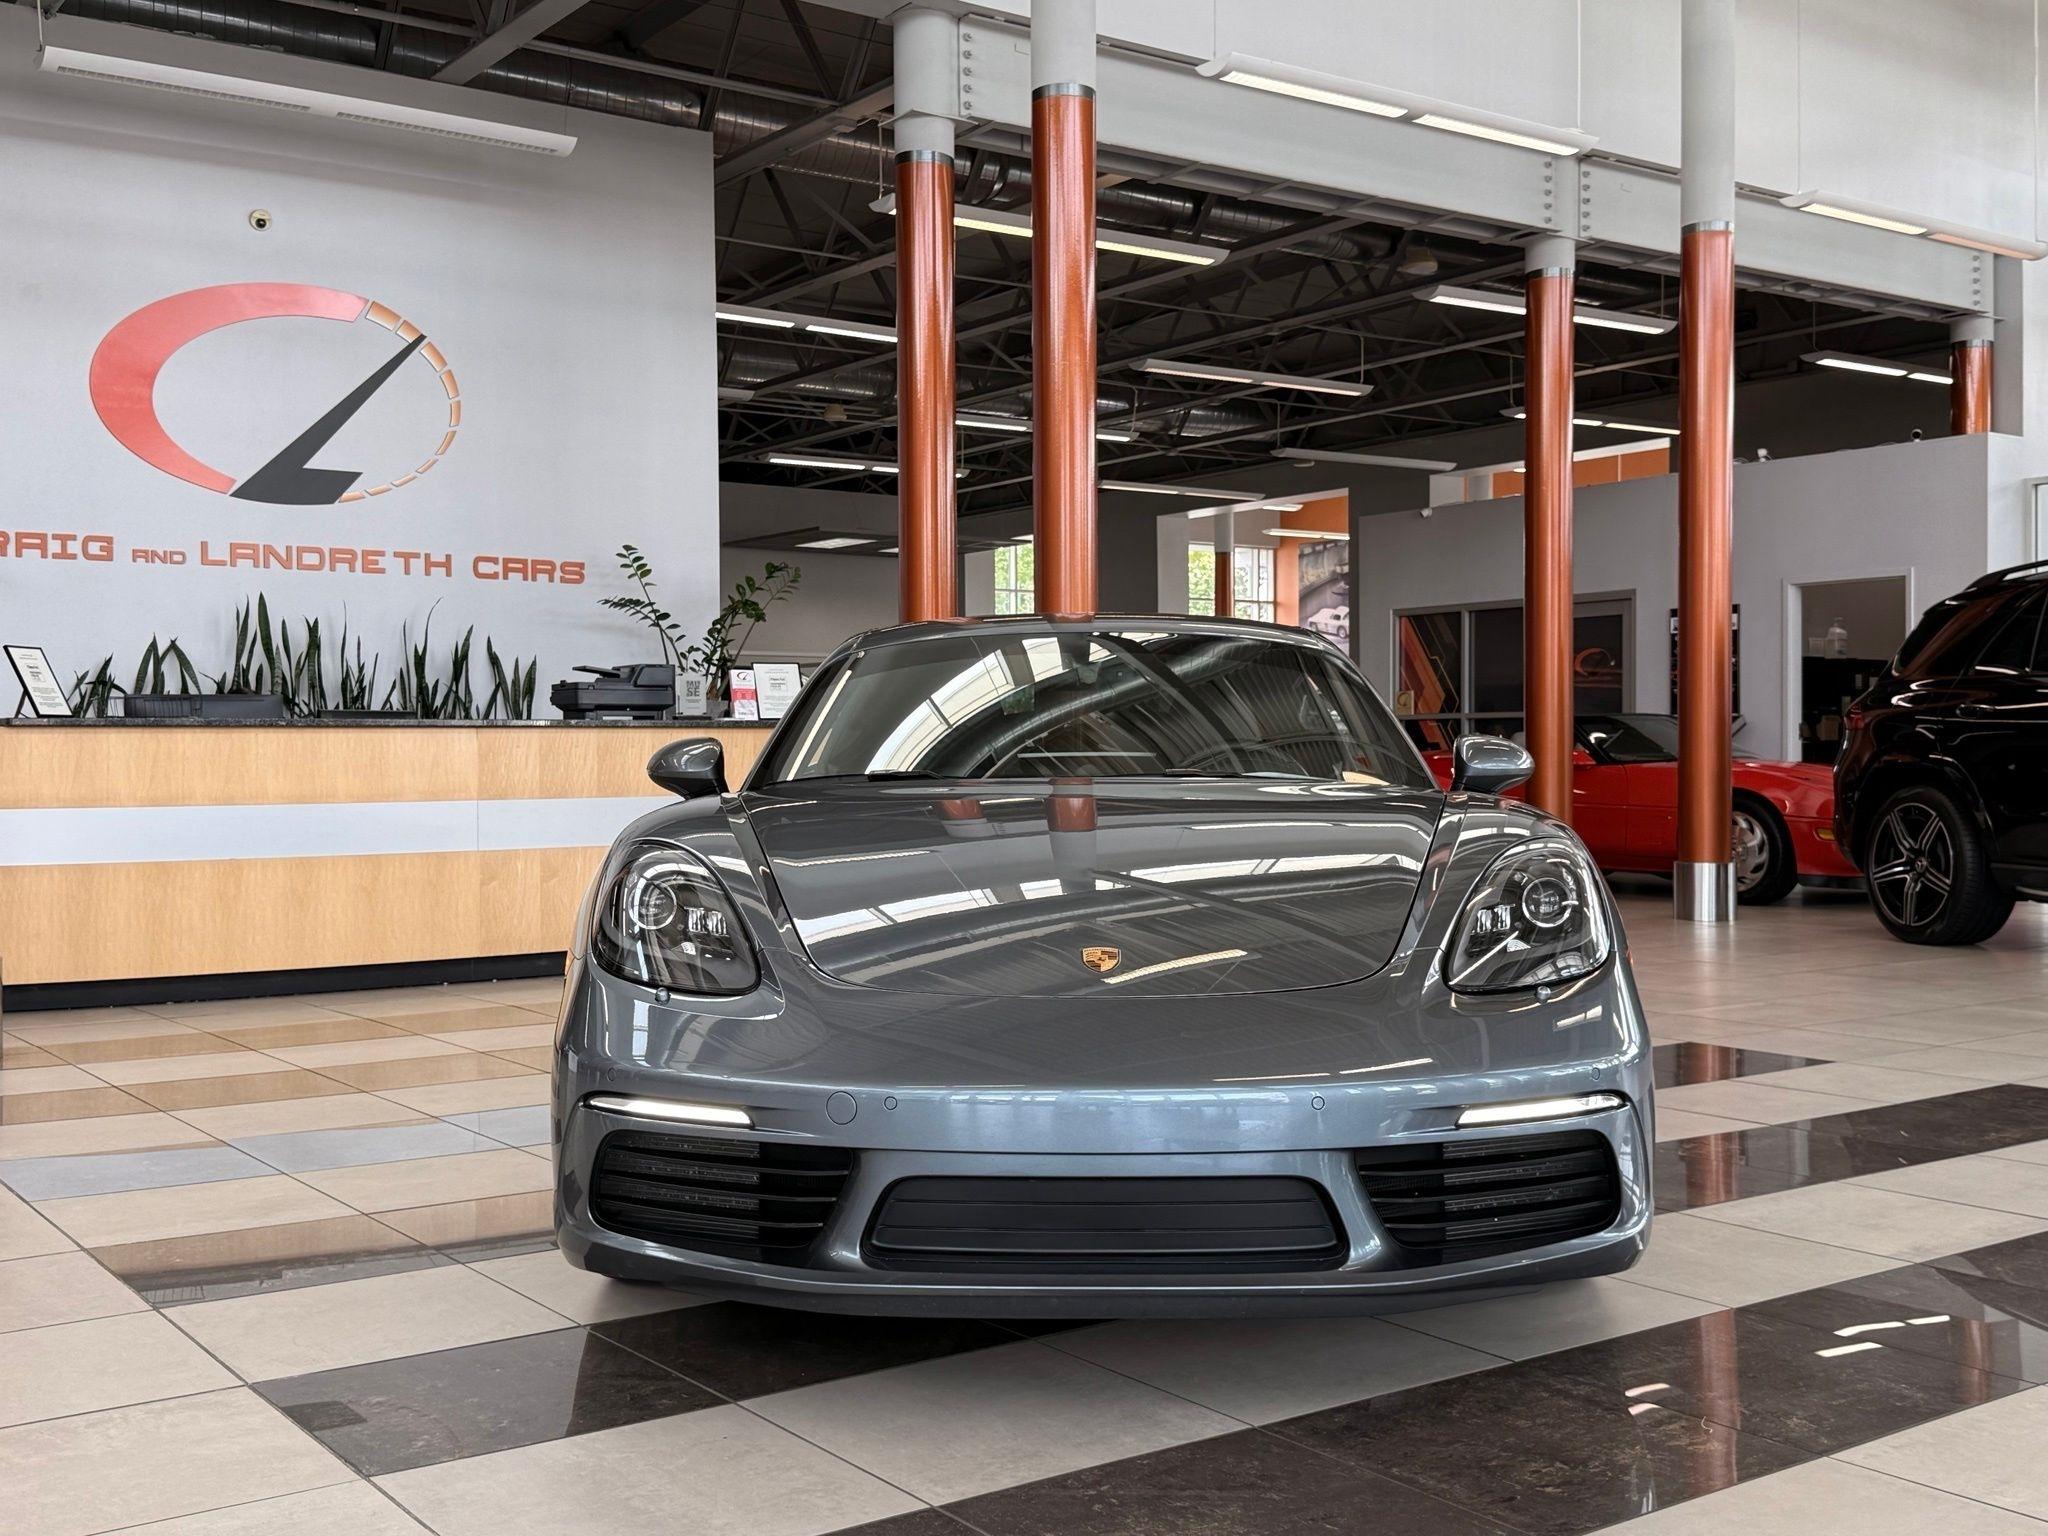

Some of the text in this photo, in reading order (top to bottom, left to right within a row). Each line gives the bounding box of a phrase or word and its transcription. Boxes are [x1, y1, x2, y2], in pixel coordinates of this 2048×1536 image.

[132, 548, 187, 565] AND
[200, 540, 452, 577] LANDRETH
[472, 555, 586, 585] CARS
